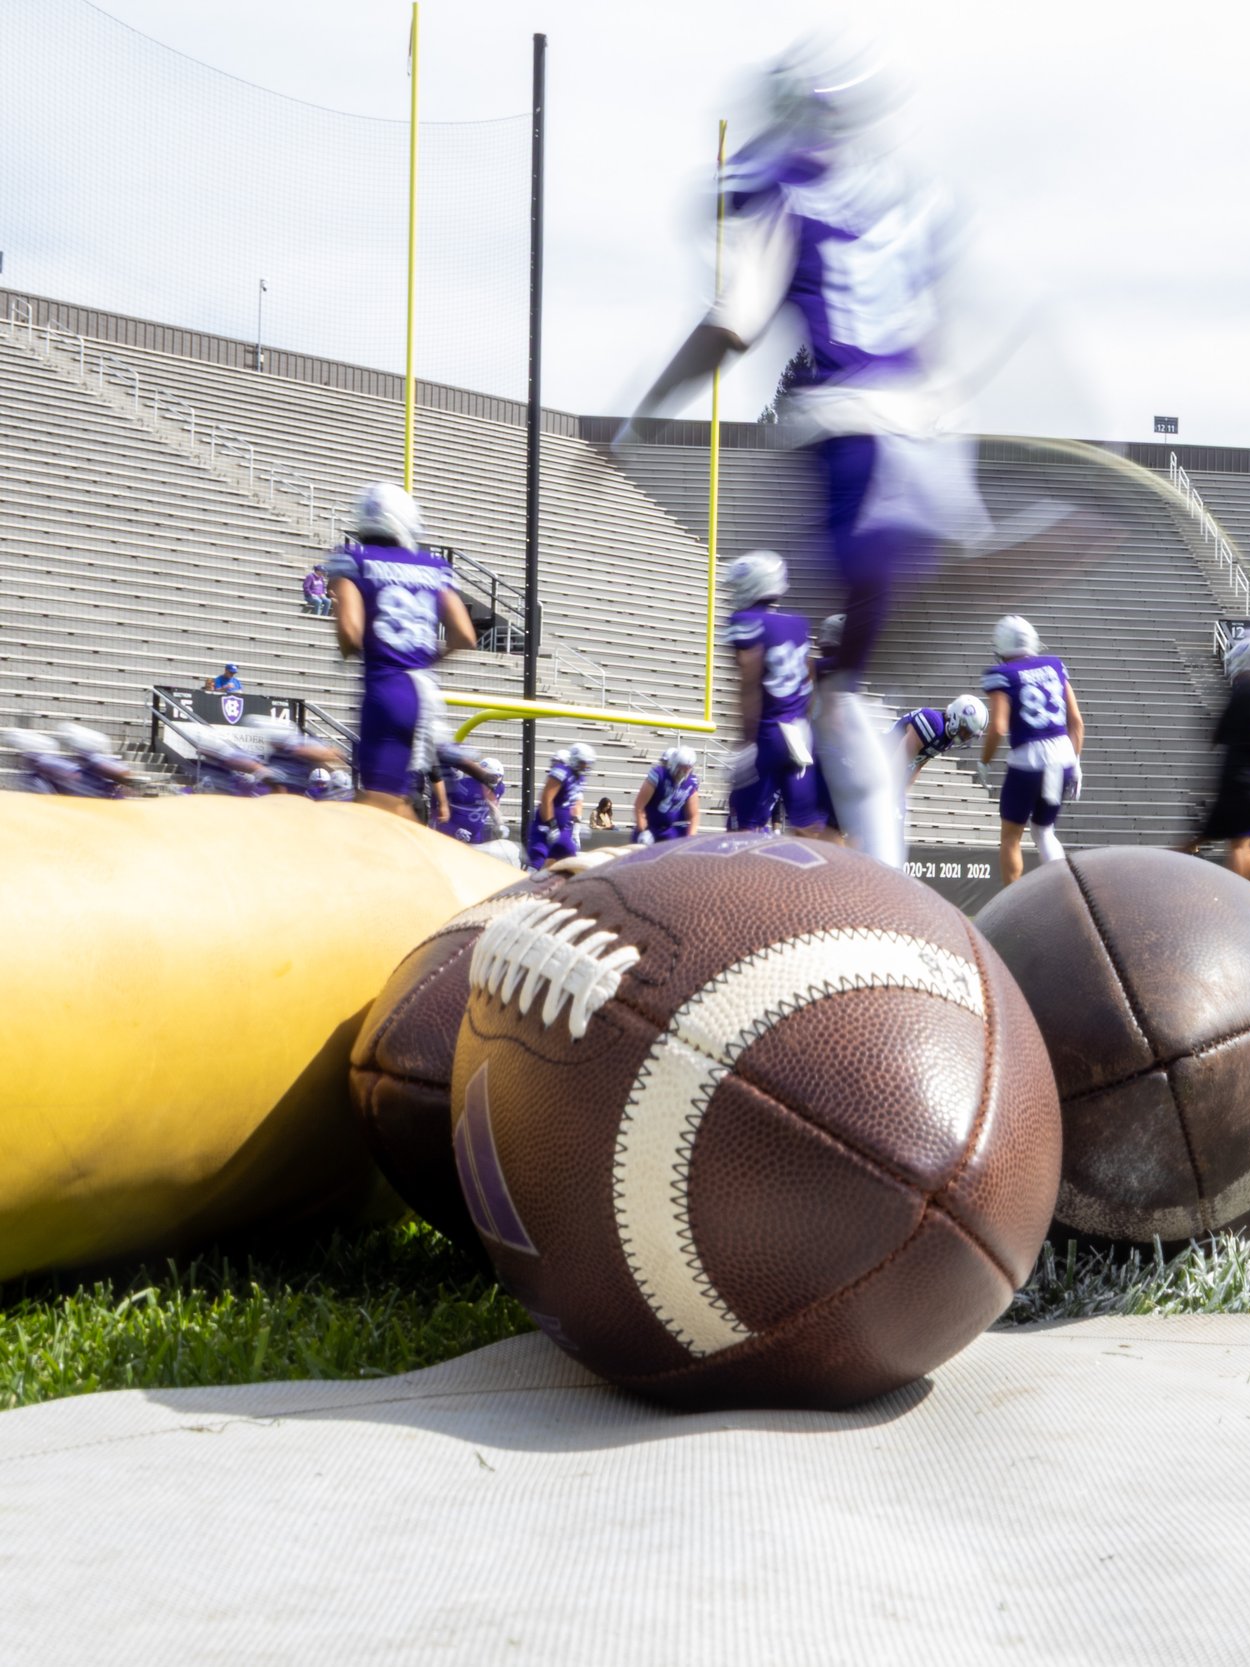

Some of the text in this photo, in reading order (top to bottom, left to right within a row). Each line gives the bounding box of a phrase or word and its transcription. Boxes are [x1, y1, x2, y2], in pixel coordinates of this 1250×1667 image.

[1157, 424, 1166, 432] 12
[1167, 424, 1175, 433] 11
[1231, 626, 1245, 639] 12
[270, 706, 290, 723] 14
[903, 862, 991, 879] 020-21 2021 2022
